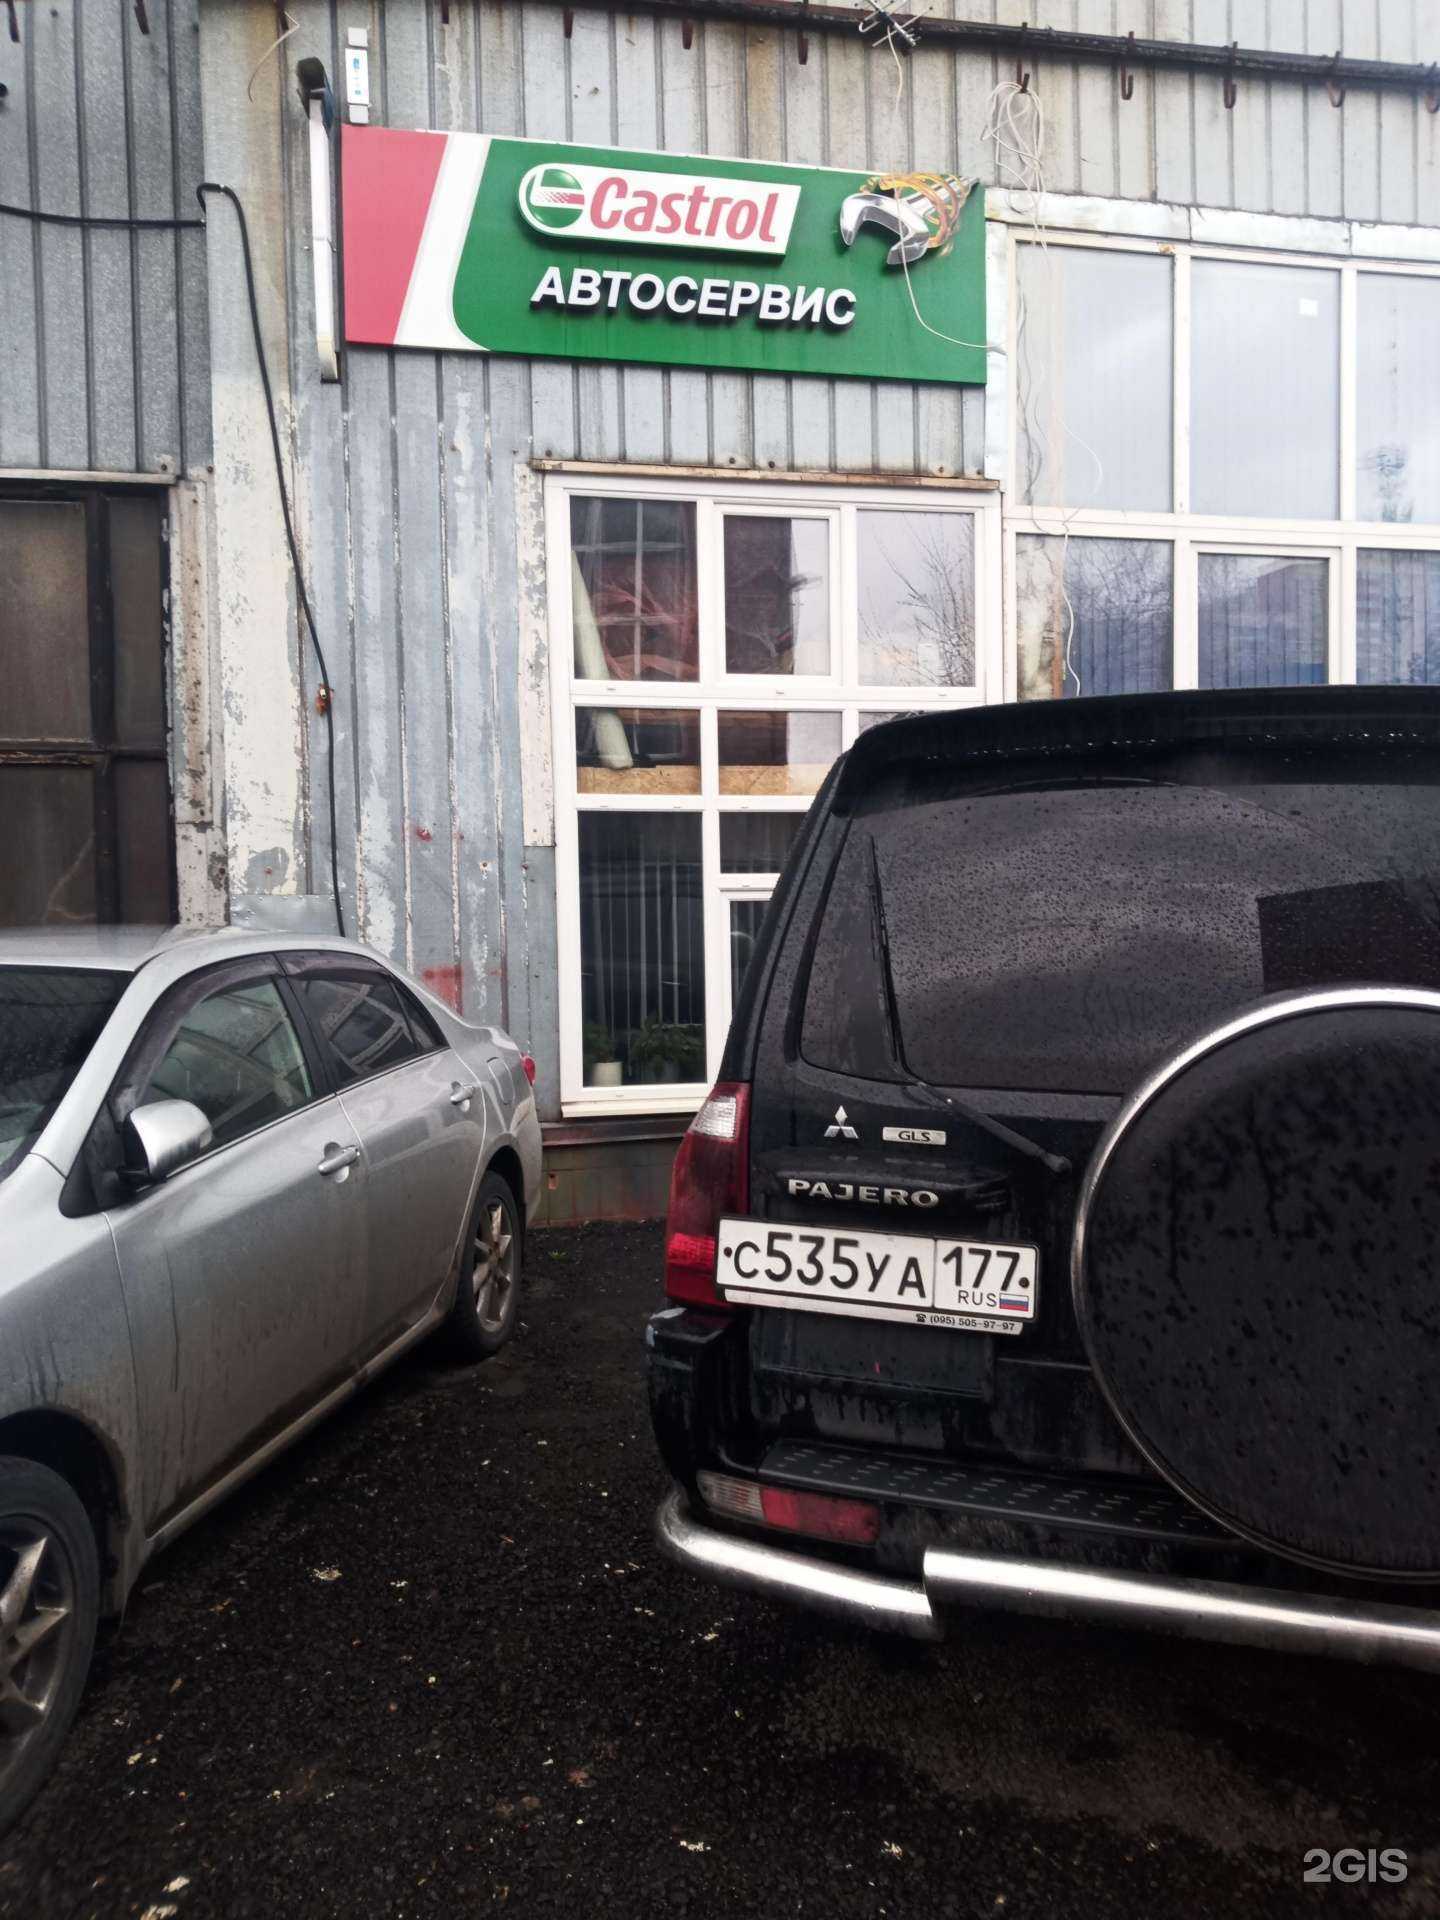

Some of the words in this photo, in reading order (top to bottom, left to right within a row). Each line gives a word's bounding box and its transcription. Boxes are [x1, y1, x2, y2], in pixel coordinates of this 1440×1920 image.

[590, 176, 779, 243] Castrol
[530, 266, 857, 327] АВТОСЕРВИС
[898, 1130, 931, 1143] GLS
[787, 1178, 940, 1208] PAJERO
[943, 1245, 1021, 1292] 177
[957, 1289, 998, 1308] RUS
